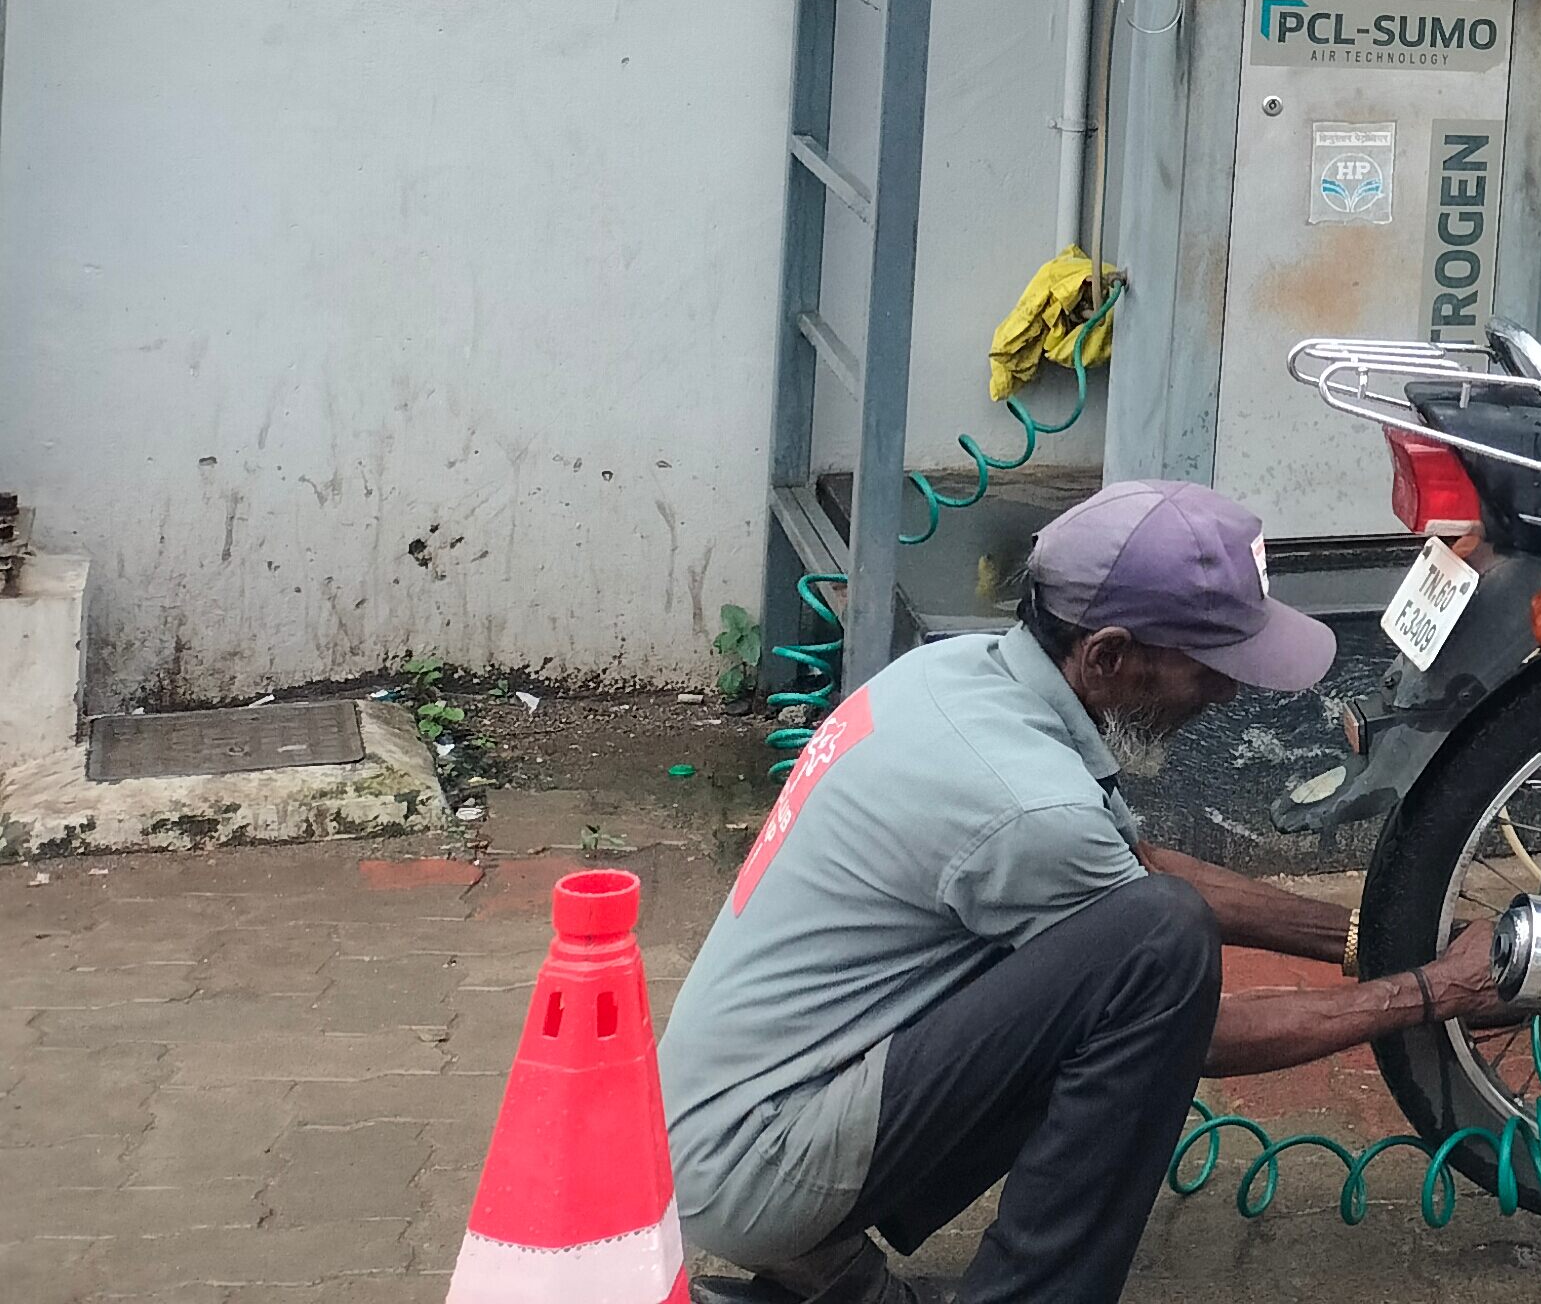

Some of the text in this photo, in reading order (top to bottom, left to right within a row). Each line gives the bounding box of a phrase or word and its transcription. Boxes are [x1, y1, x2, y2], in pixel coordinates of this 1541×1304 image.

[1277, 11, 1498, 51] PCL-SUMO
[1310, 50, 1449, 65] AIR TECHNOLOGY
[1336, 161, 1371, 180] HP
